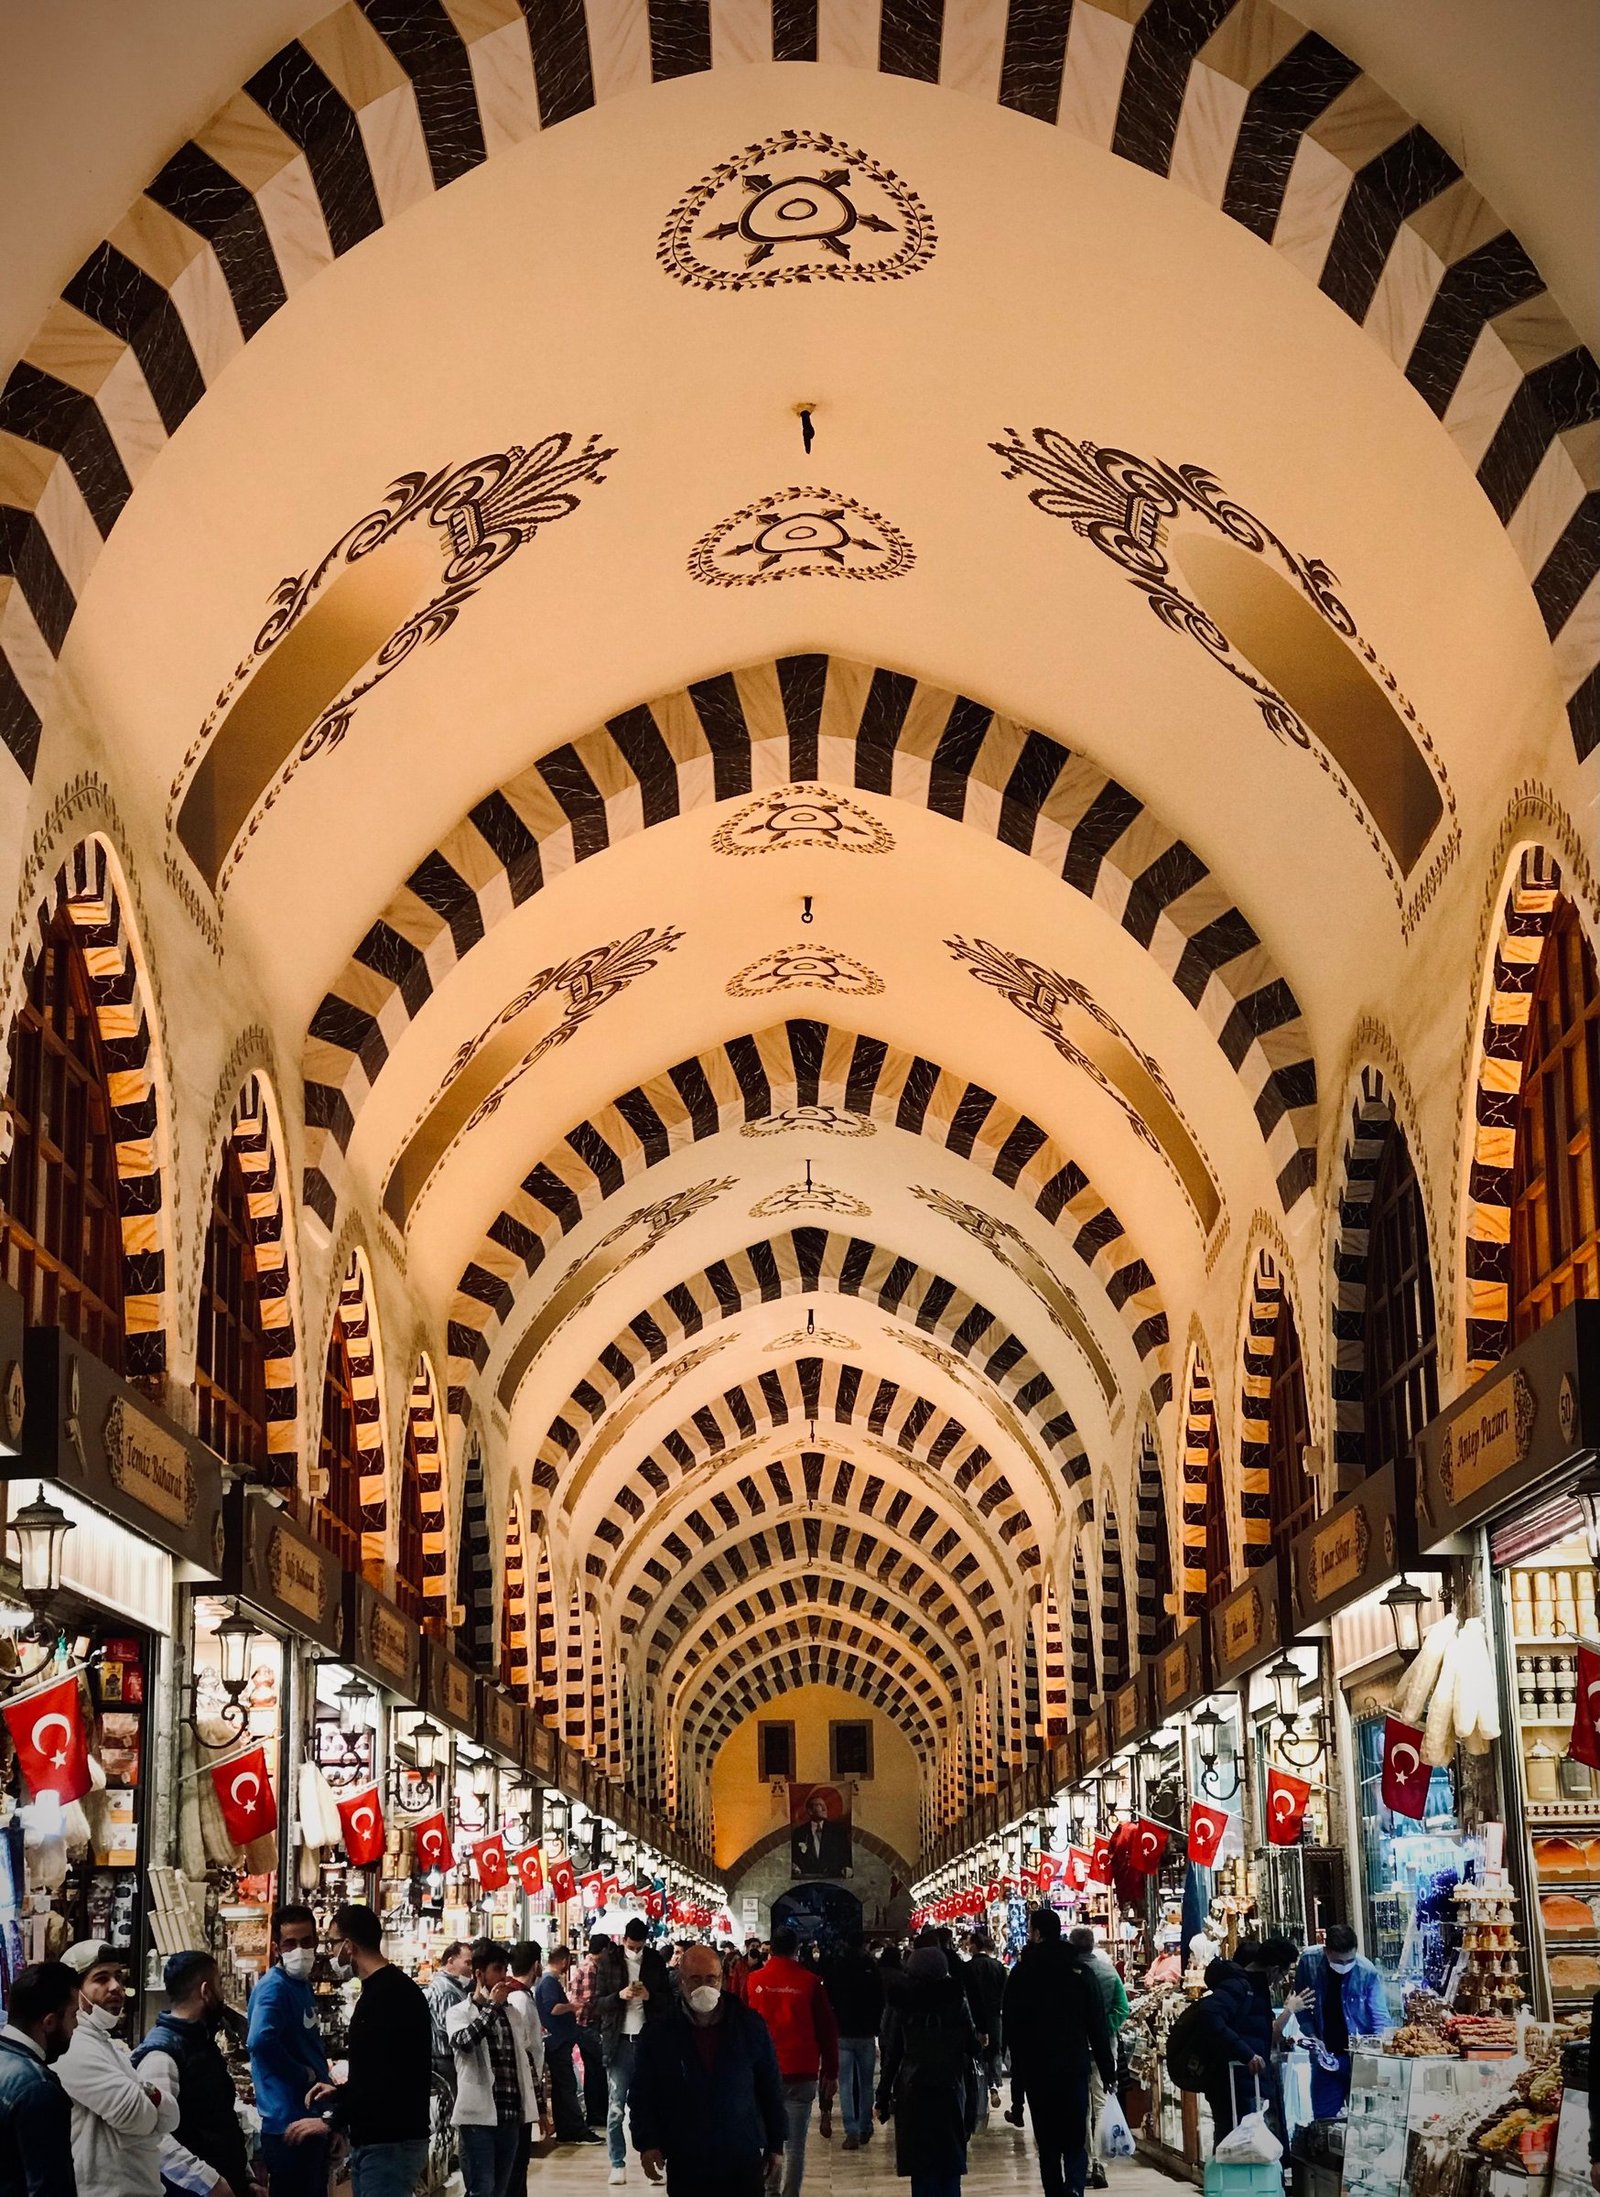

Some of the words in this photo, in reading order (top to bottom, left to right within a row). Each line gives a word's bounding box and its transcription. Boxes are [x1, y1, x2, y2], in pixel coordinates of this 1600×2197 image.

[13, 1385, 21, 1418] 41
[1561, 1393, 1571, 1424] 50
[1457, 1430, 1479, 1467] Antep
[127, 1435, 150, 1478] Temiz
[152, 1456, 182, 1501] Baharat
